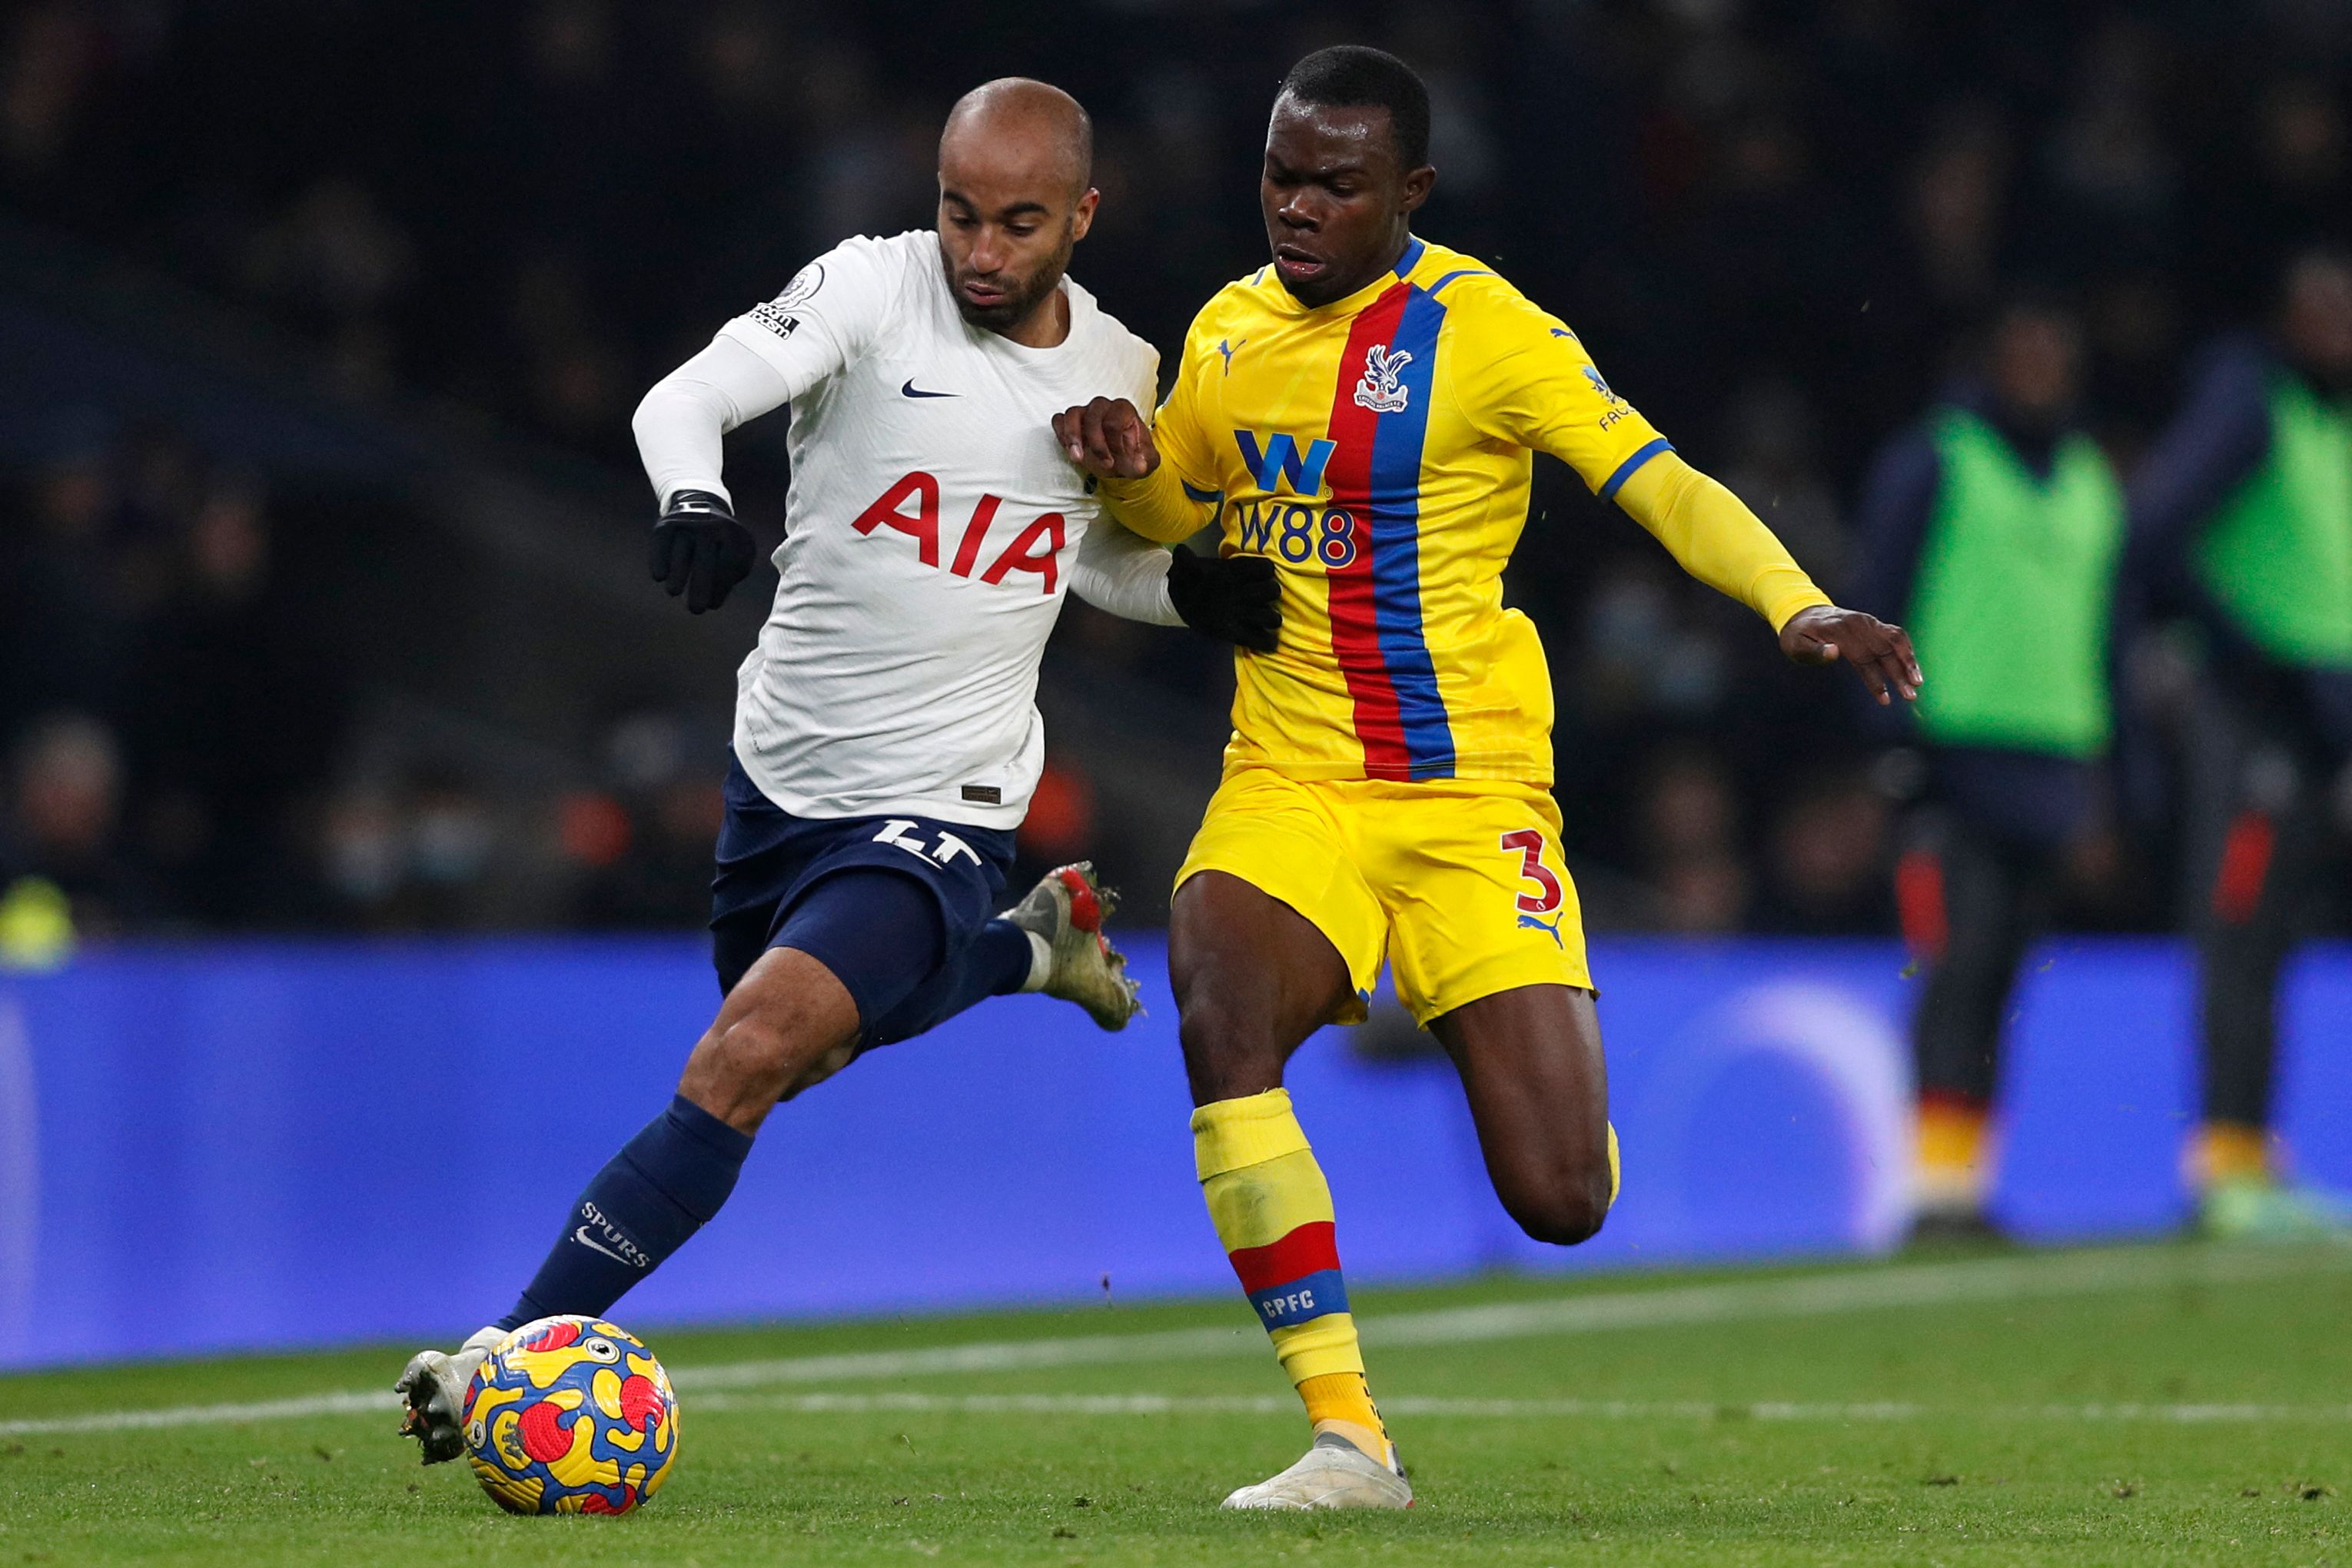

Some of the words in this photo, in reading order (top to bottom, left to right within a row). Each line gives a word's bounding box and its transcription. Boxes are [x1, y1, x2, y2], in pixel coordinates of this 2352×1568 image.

[851, 470, 1065, 595] AIA
[1234, 500, 1357, 568] W88
[872, 819, 983, 870] LT
[1500, 828, 1563, 915] 3
[581, 1201, 650, 1267] SPURS
[1262, 1289, 1315, 1318] CPFC
